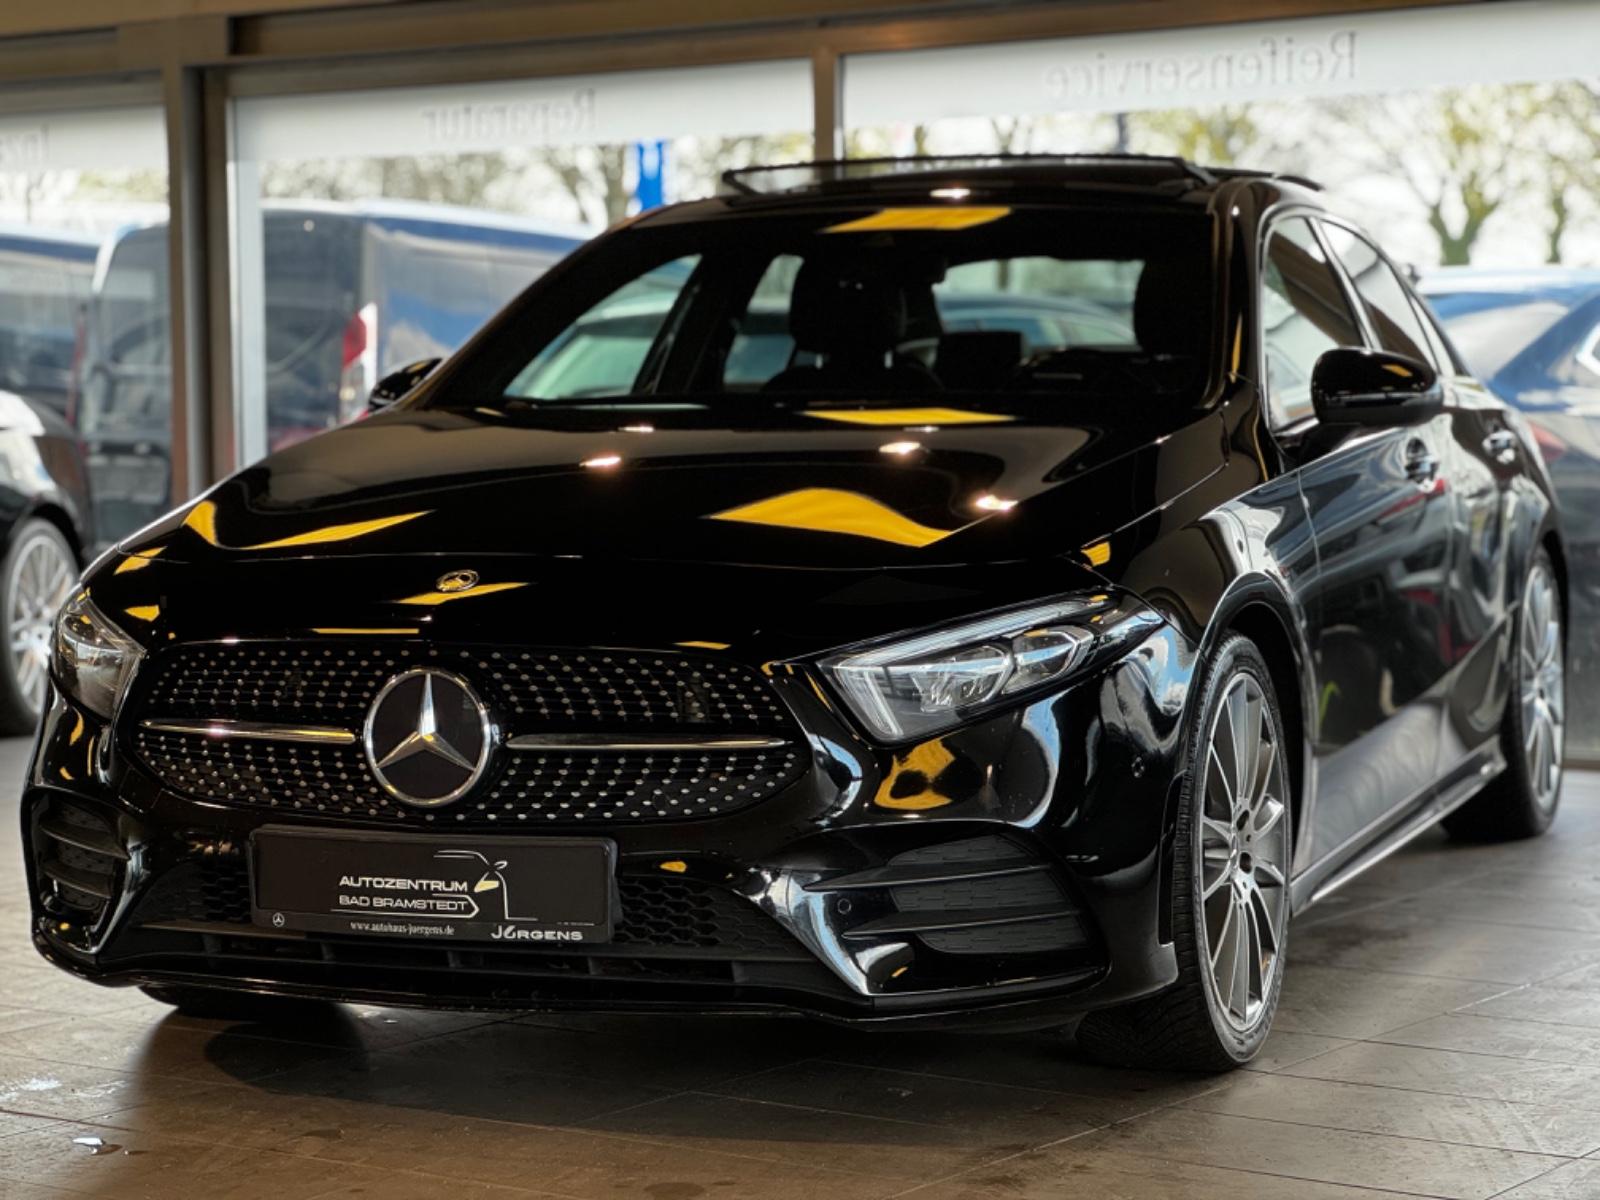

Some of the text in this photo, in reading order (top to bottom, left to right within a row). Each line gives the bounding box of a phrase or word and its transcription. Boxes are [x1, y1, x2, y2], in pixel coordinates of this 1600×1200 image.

[339, 875, 468, 892] AUTOZENTRUM
[339, 894, 469, 911] BAD BRAMSTEDT
[350, 922, 455, 937] www.autohaus-juergens.de
